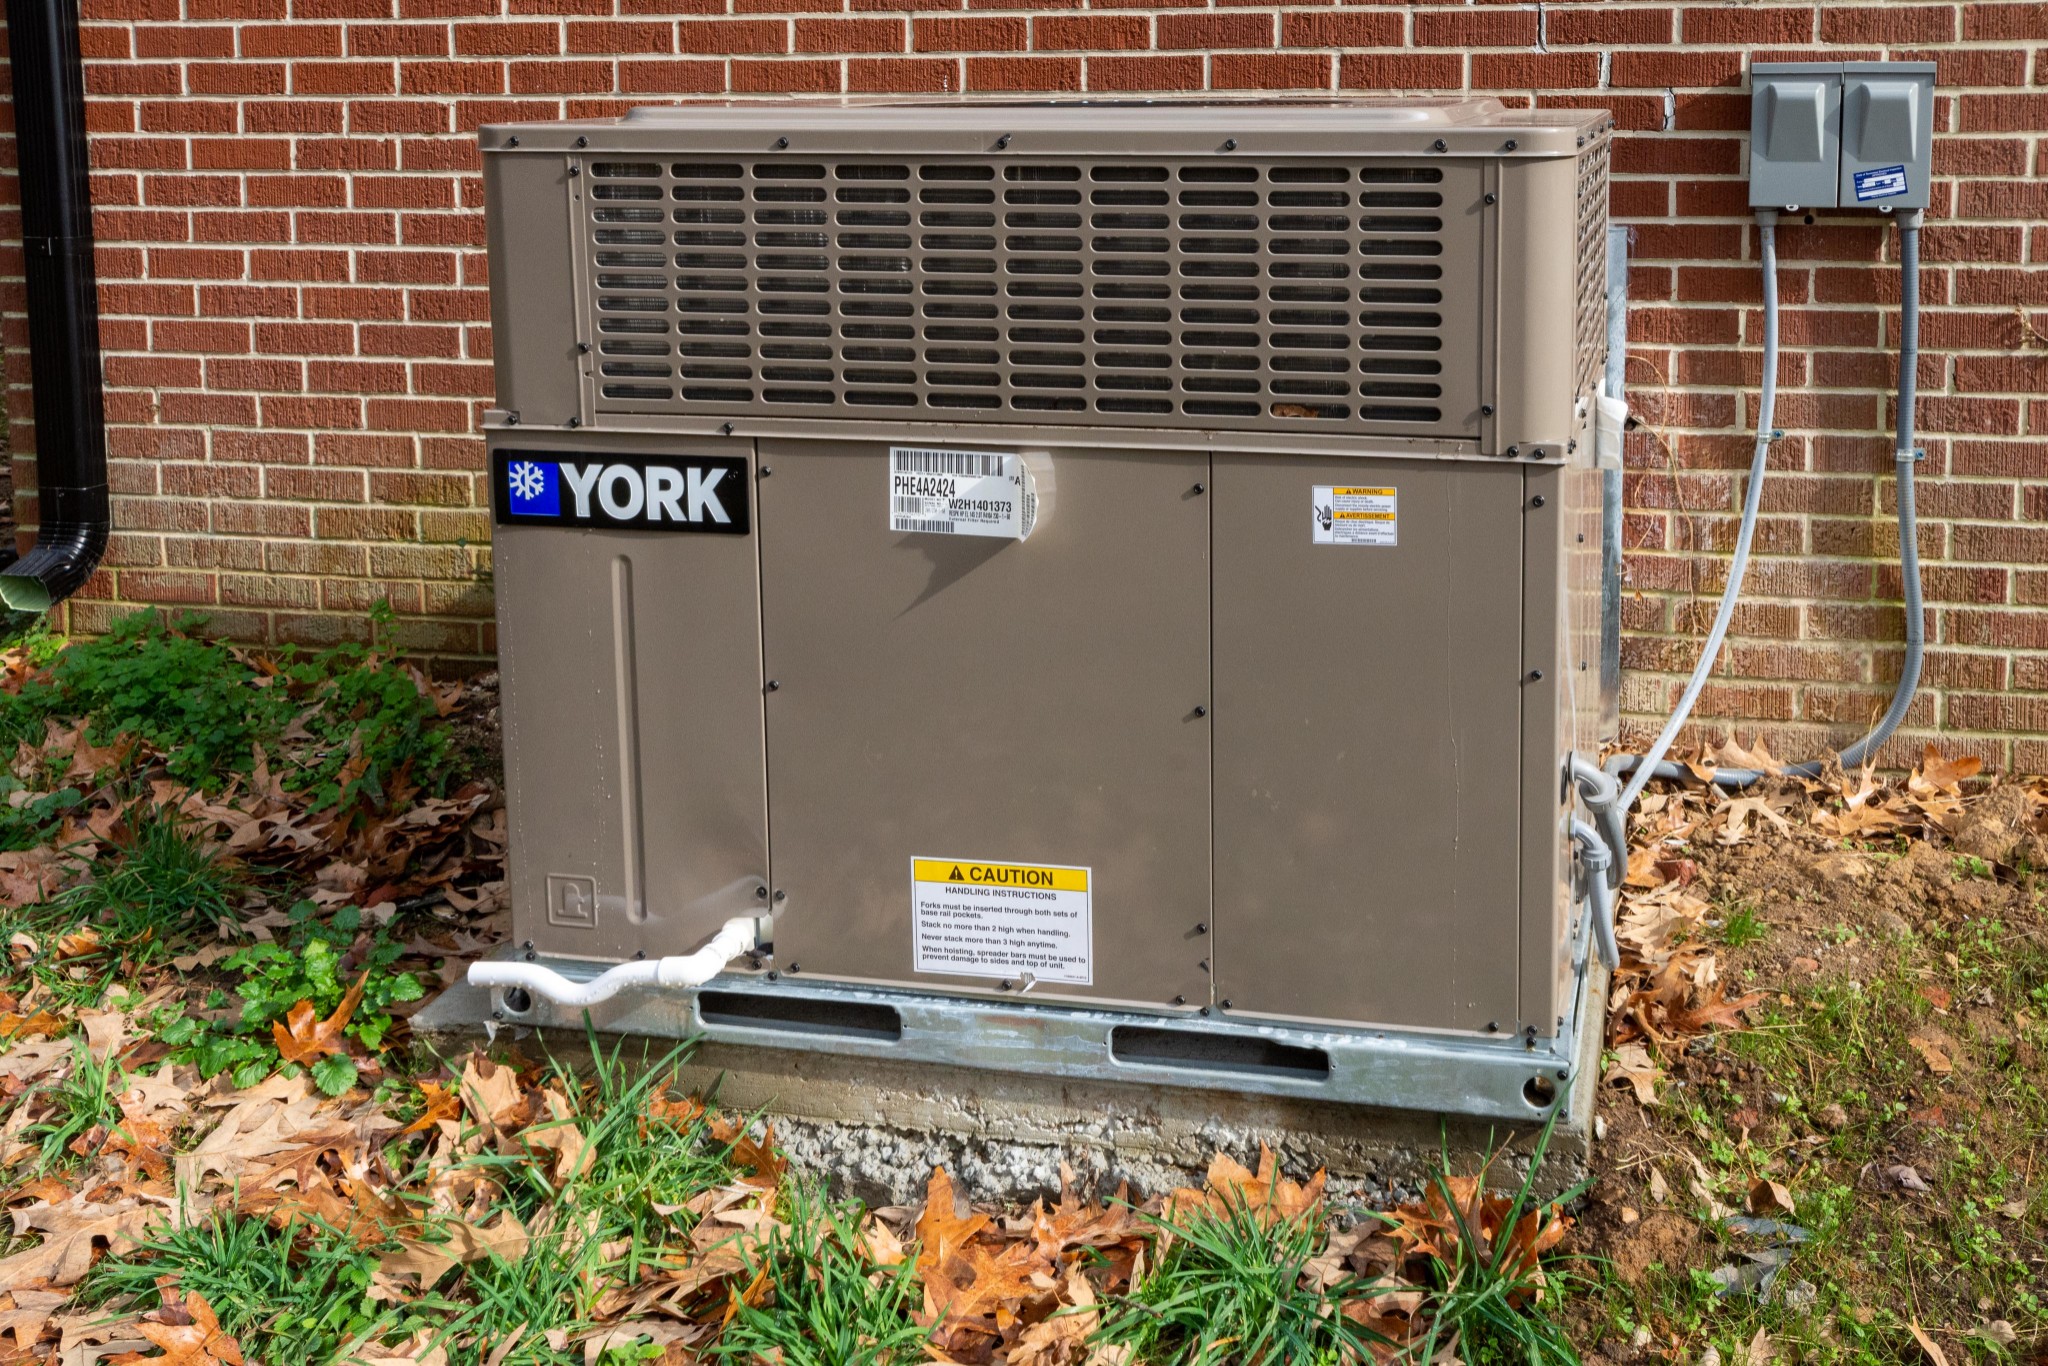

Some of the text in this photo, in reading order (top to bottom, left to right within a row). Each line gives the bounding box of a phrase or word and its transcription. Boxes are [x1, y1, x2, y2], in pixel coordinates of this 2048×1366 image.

[559, 462, 731, 524] YORK
[894, 475, 955, 498] PHE4A2424
[948, 498, 1012, 512] W2H1401373
[969, 866, 1053, 886] CAUTION
[945, 886, 1057, 901] HANDLING INSTRUCTIONS
[920, 901, 940, 909] Forks
[973, 904, 1002, 913] inserted
[1004, 906, 1033, 916] through
[1034, 908, 1051, 916] both
[952, 911, 983, 919] pockets.
[921, 920, 941, 928] Stack
[974, 924, 990, 932] than
[998, 925, 1014, 935] high
[1016, 926, 1035, 935] when
[1037, 928, 1071, 939] handling.
[921, 933, 942, 941] Never
[943, 935, 963, 943] stack
[985, 937, 1001, 945] than
[1009, 938, 1025, 947] high
[1026, 940, 1058, 949] anytime.
[921, 945, 942, 953] When
[976, 949, 1009, 958] spreader
[1010, 951, 1026, 959] bars
[1058, 955, 1077, 963] used
[950, 954, 979, 964] damage
[980, 956, 988, 964] to
[989, 957, 1009, 965] sides
[1026, 960, 1039, 968] top
[1049, 962, 1065, 970] unit.
